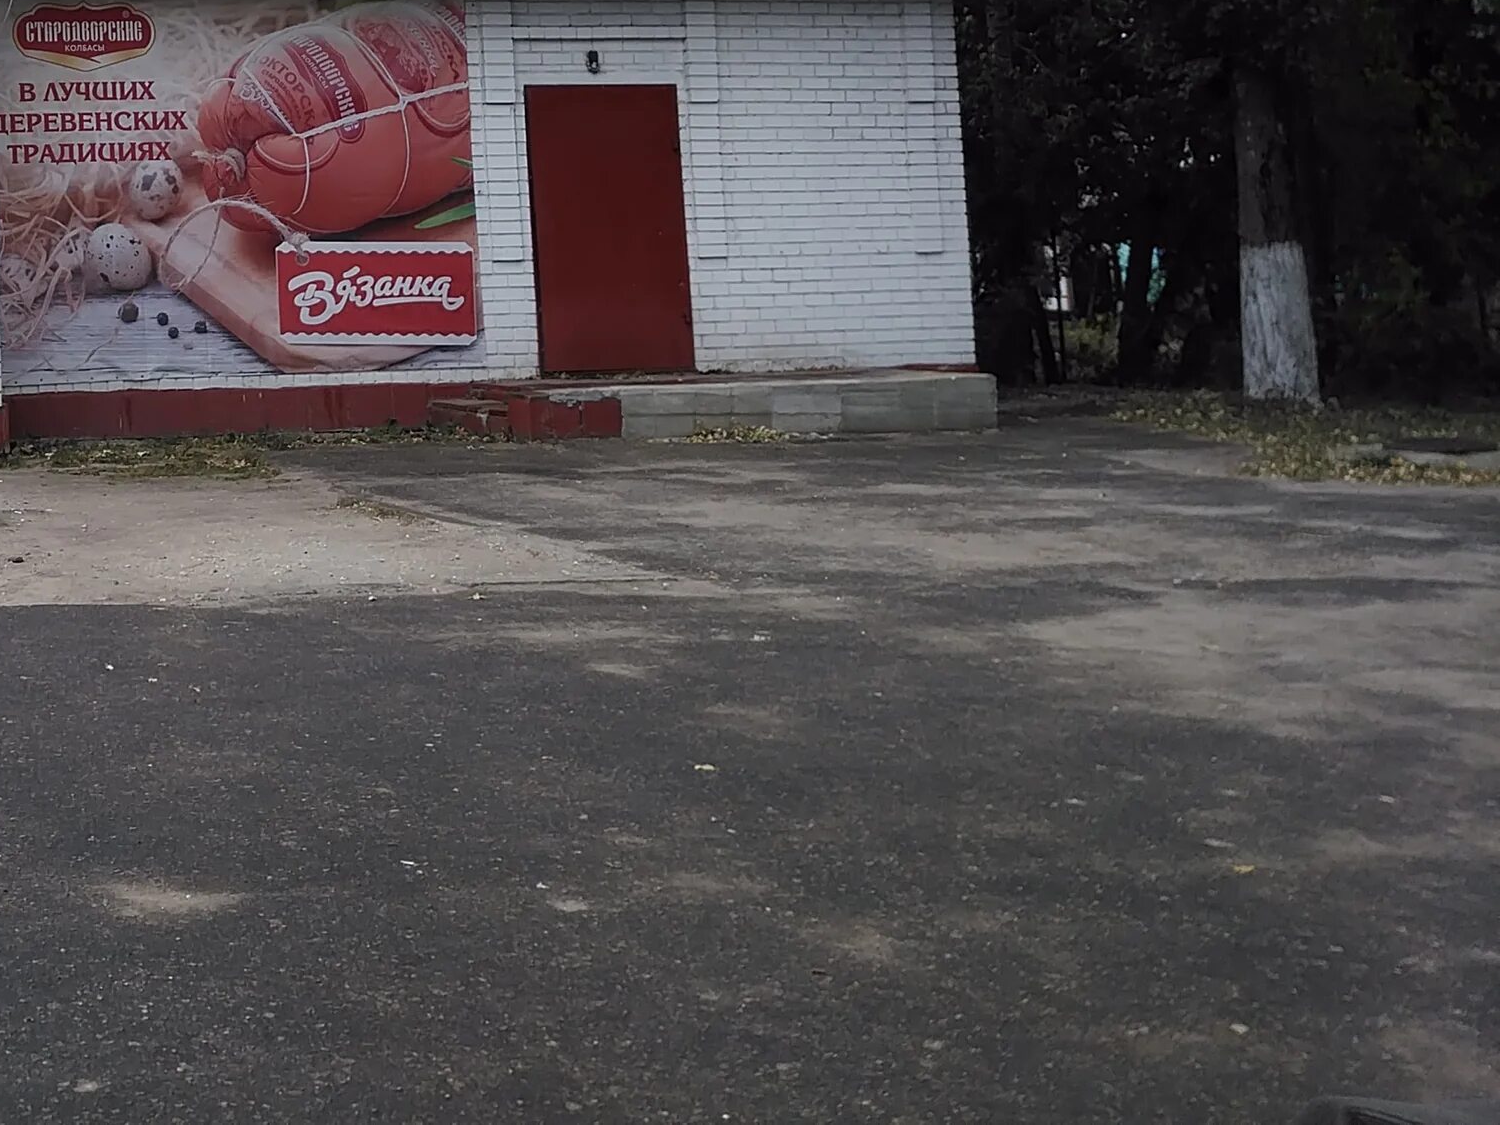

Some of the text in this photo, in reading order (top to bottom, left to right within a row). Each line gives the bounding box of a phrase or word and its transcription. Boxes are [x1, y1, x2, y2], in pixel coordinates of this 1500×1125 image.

[25, 20, 143, 43] СТАРОДВОРСКИЕ
[64, 44, 105, 52] КОЛБАСЫ
[18, 81, 156, 102] В ЛУЧШИХ
[7, 141, 173, 165] ТРАДИЦИЯХ
